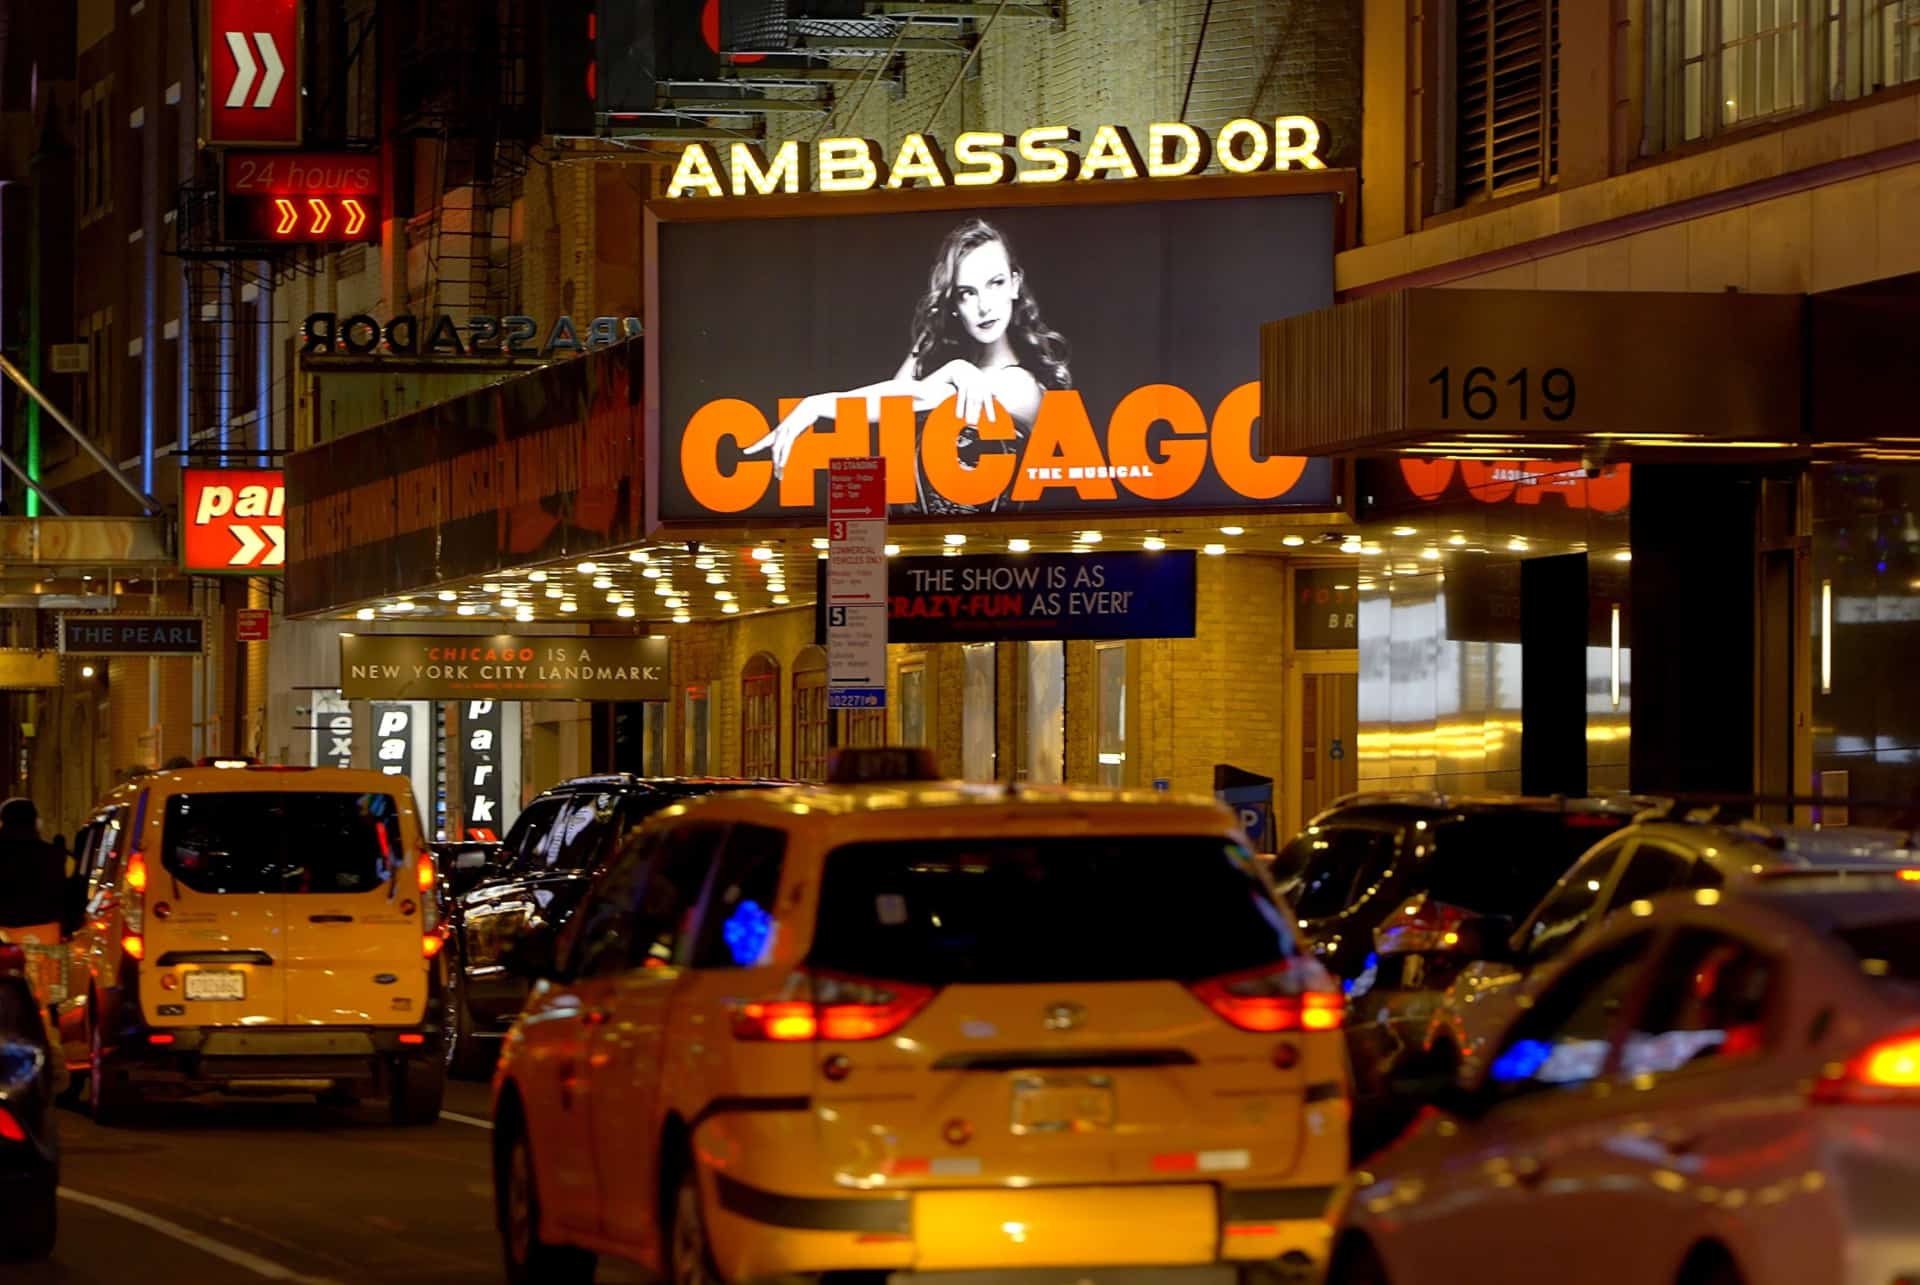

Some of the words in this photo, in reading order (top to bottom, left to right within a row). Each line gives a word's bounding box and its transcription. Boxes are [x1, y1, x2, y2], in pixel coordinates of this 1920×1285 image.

[666, 116, 1326, 199] AMBASSADOR
[236, 160, 275, 189] 24
[287, 160, 371, 190] hours
[1428, 366, 1576, 421] 1619
[680, 382, 1310, 513] CHICAGO
[1027, 468, 1062, 480] THE
[1068, 465, 1152, 479] MUSICAL
[833, 522, 843, 540] 3
[962, 568, 1038, 590] SHOW
[1048, 567, 1065, 588] IS
[1073, 566, 1105, 588] AS
[1029, 594, 1060, 615] AS
[832, 607, 843, 625] 5
[71, 627, 113, 643] THE
[121, 626, 198, 644] PEARL
[548, 648, 566, 662] IS
[579, 648, 592, 662] A
[351, 665, 401, 680] NEW
[413, 665, 468, 680] YORK
[480, 665, 527, 680] CITY
[377, 711, 408, 775] pa
[1240, 809, 1259, 832] P
